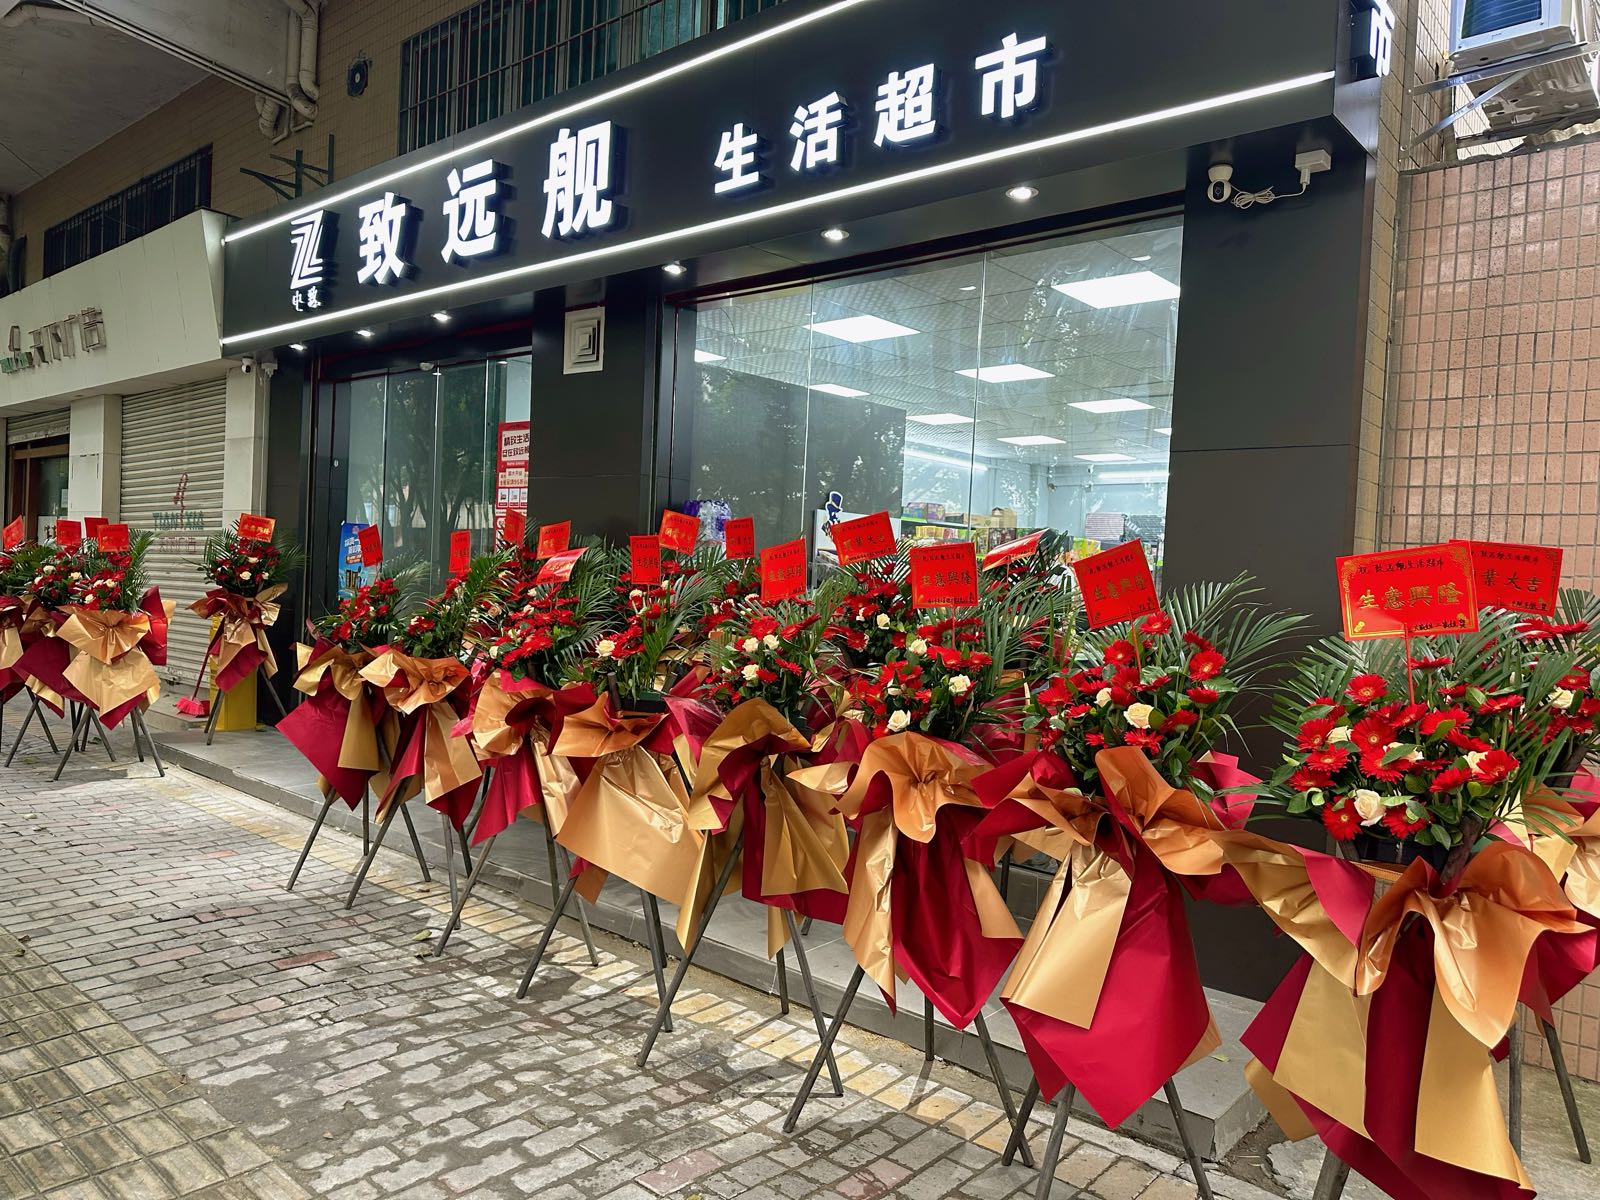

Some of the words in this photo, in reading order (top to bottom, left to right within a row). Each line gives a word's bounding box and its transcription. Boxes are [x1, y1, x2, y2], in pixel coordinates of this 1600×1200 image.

[356, 120, 613, 285] 致远舰
[713, 32, 1048, 194] 生活超市
[1474, 567, 1544, 593] 業大吉
[1357, 581, 1464, 611] 生意興隆
